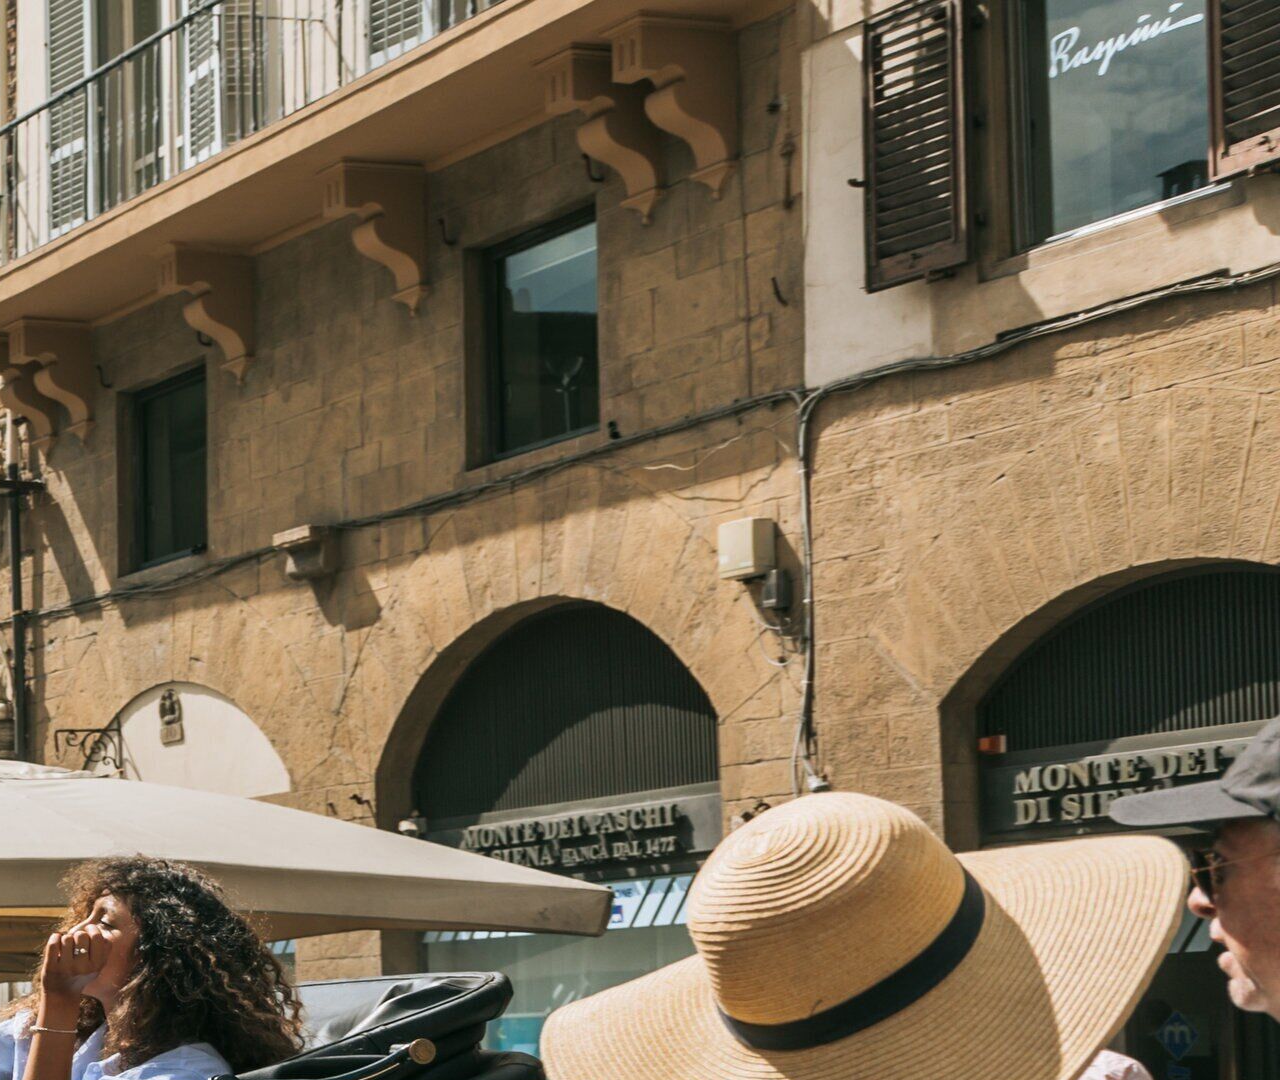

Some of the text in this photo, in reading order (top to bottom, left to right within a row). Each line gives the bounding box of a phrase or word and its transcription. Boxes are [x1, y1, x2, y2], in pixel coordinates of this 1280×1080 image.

[1048, 2, 1204, 78] Raspini
[1013, 746, 1221, 795] MONTE DEI
[462, 803, 677, 849] MONTE DEI PASCHI
[1013, 783, 1162, 826] DI SIE
[561, 844, 609, 864] BANCA
[612, 840, 642, 858] DAL
[646, 836, 677, 855] 1472
